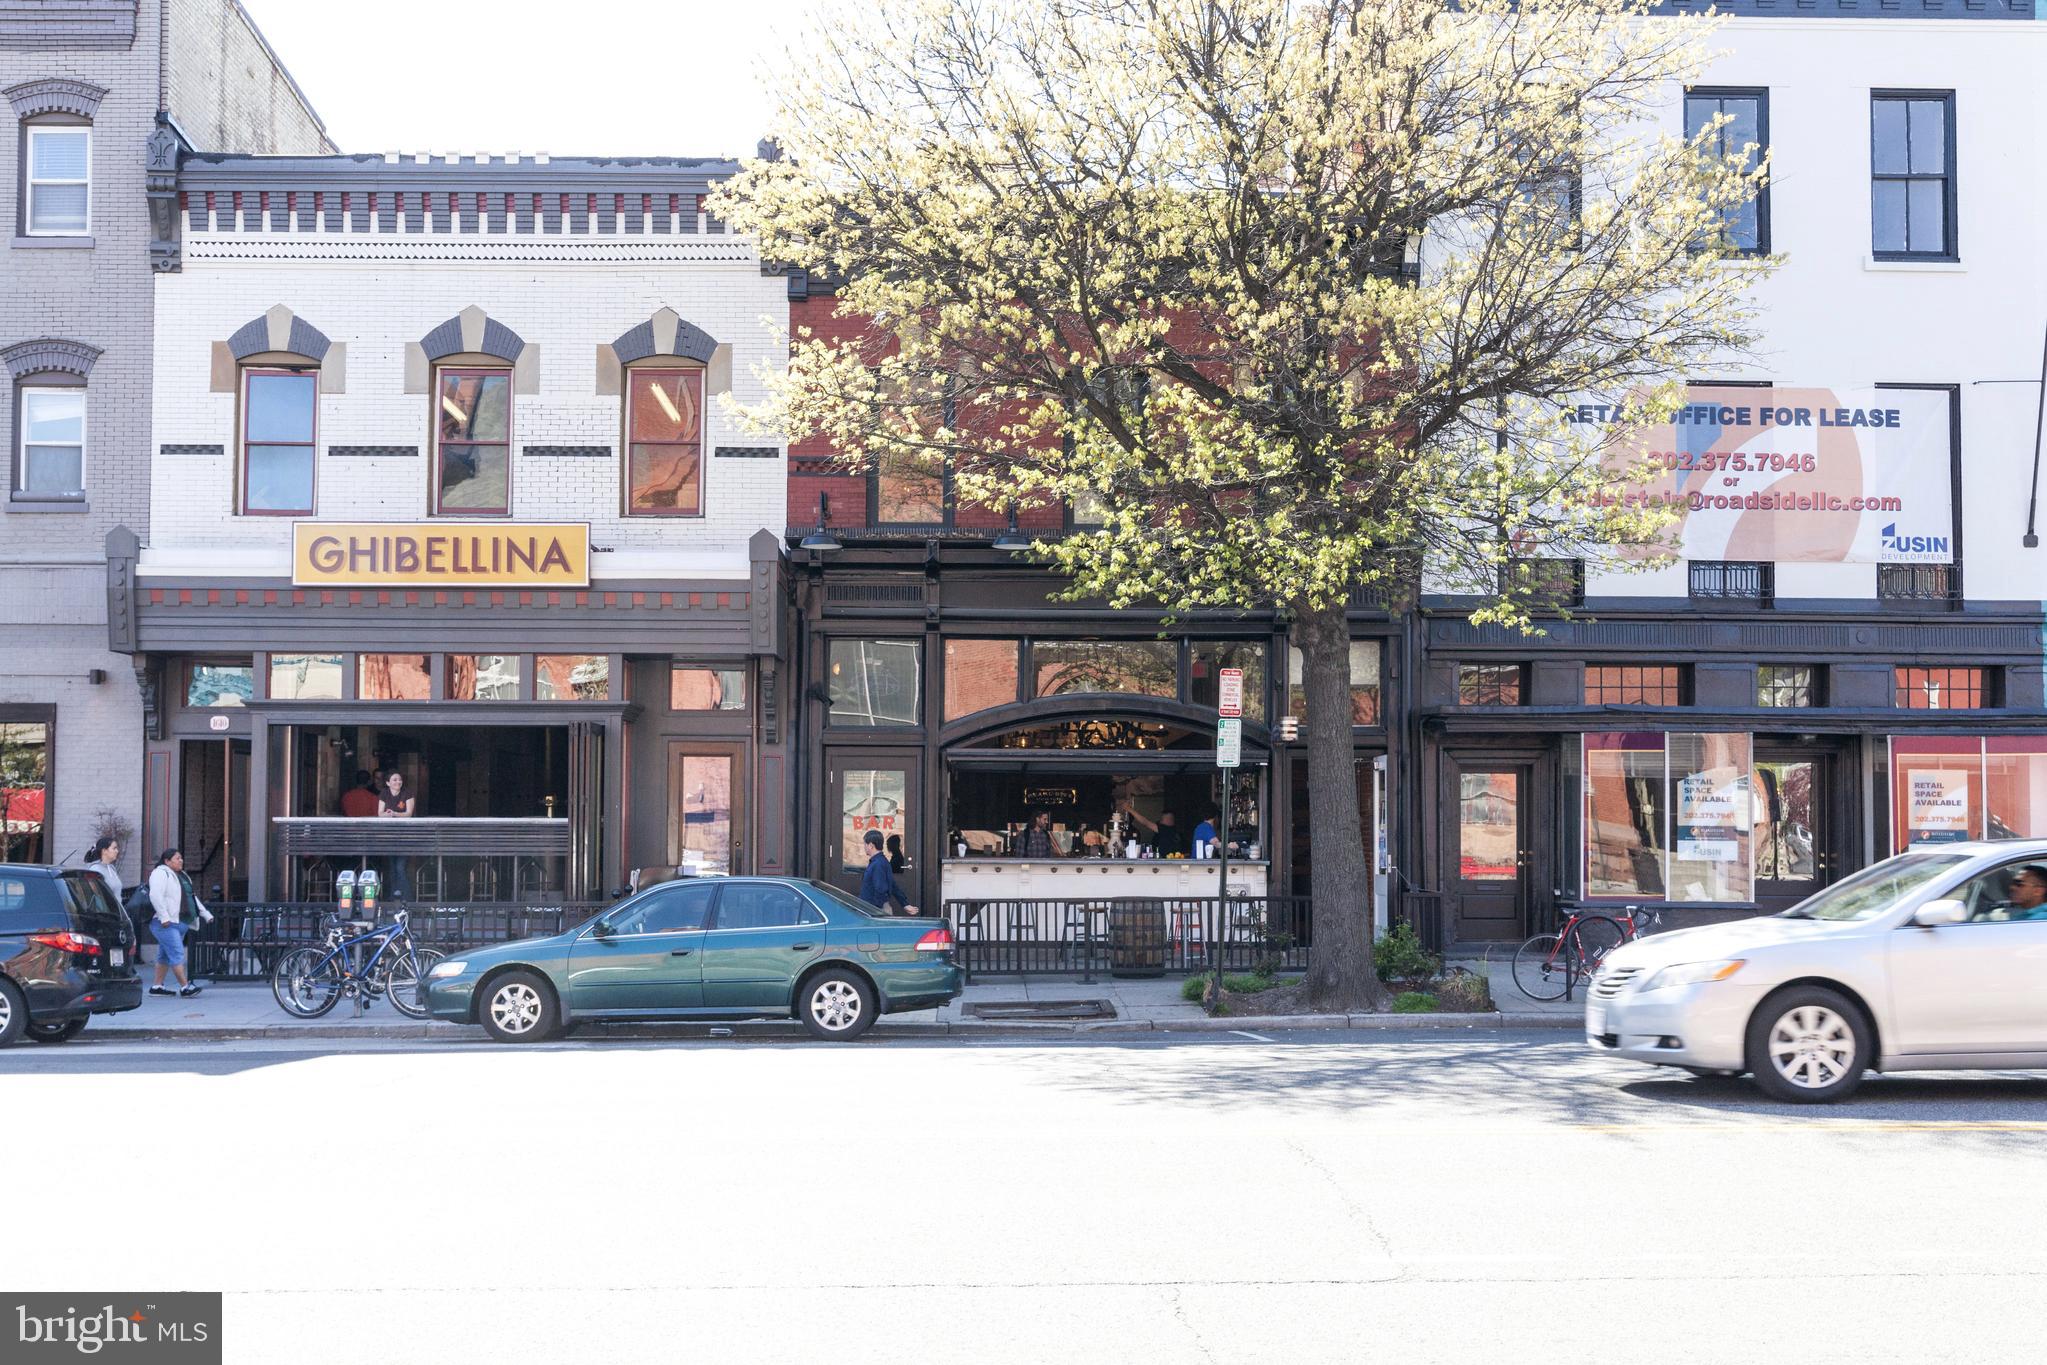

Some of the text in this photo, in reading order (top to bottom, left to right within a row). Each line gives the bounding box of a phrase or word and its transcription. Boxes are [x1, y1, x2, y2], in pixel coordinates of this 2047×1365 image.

[1759, 407, 1811, 426] FOR
[1820, 408, 1900, 427] LEASE
[1648, 451, 1815, 472] 202.375.7946
[1723, 476, 1739, 486] or
[308, 535, 573, 574] GHIBELLINA
[1881, 553, 1948, 561] DEVELOPMENT
[852, 815, 895, 830] BAR
[366, 886, 371, 894] 2
